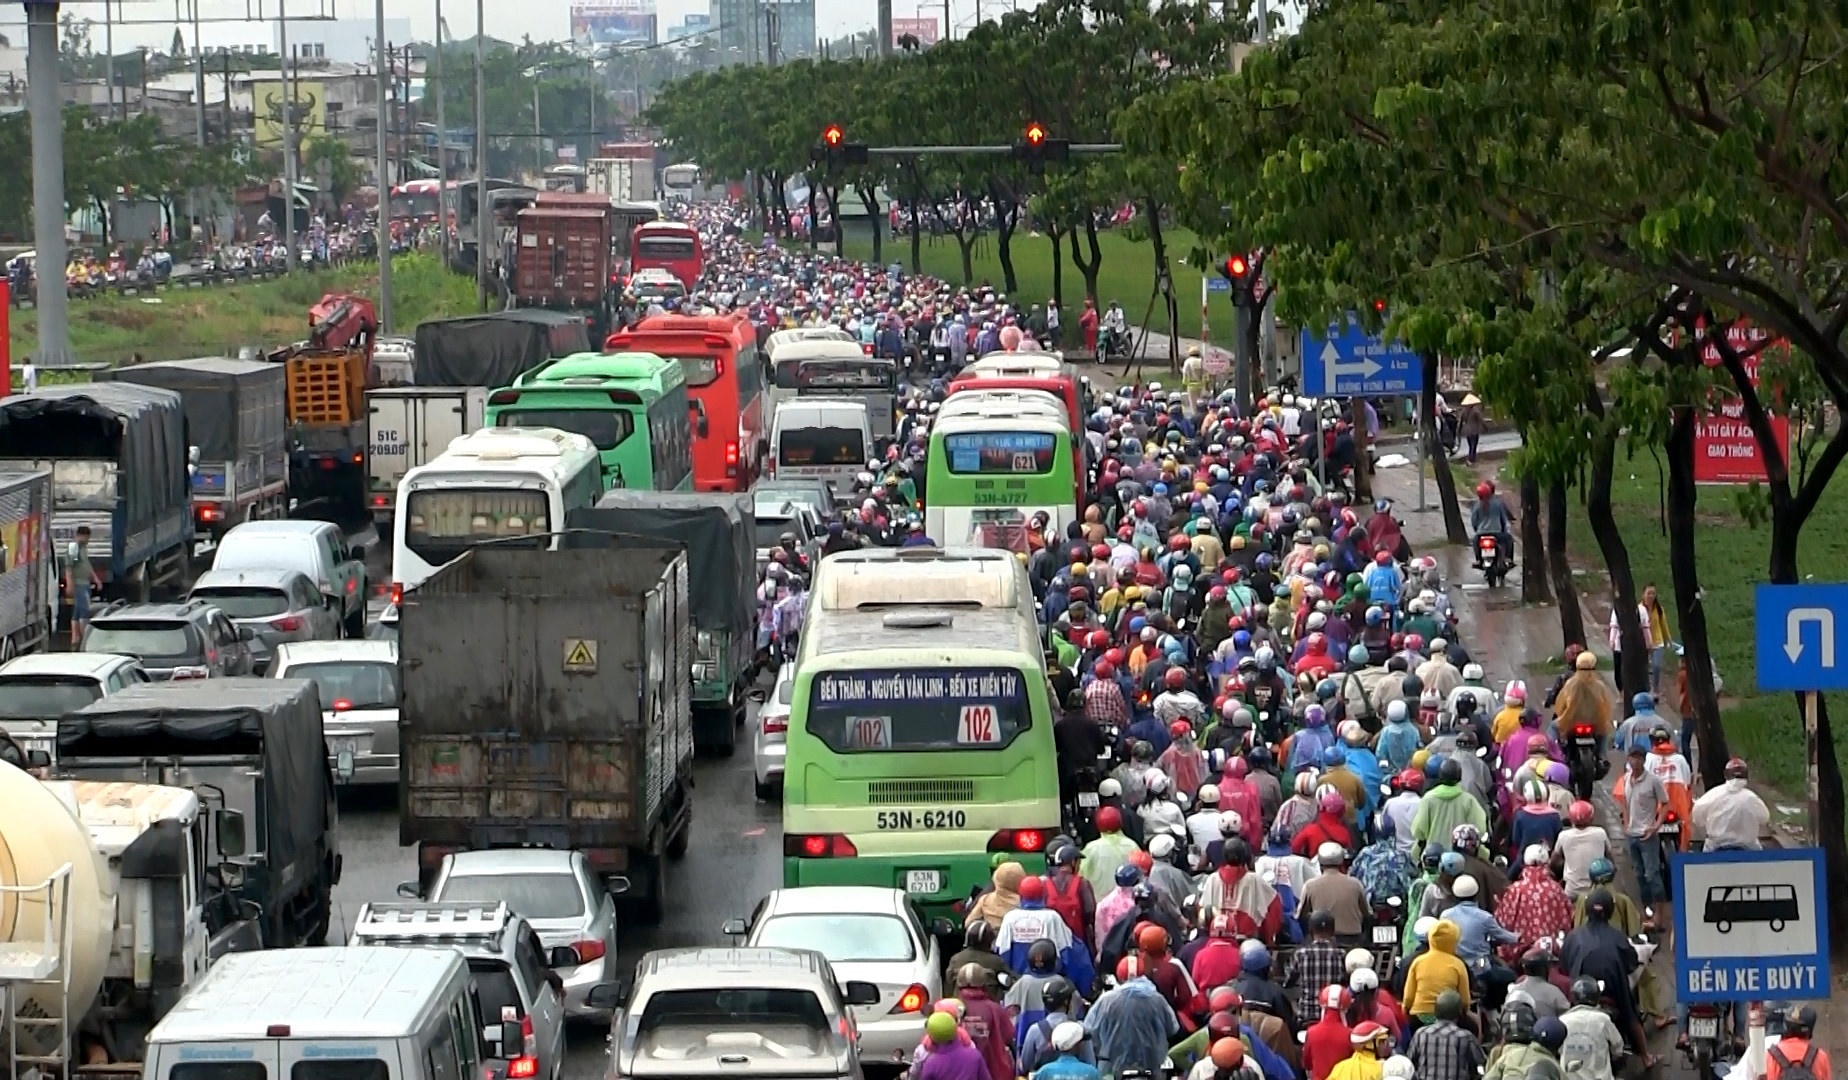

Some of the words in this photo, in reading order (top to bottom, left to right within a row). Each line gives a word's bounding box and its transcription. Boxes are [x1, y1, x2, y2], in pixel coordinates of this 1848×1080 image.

[1707, 443, 1726, 457] GIAO
[1727, 442, 1754, 458] THÔNG
[820, 676, 838, 701] BẾN
[838, 677, 866, 699] THÀNH
[924, 678, 944, 698] LINH
[949, 672, 966, 697] BẾN
[967, 677, 979, 697] XE
[1001, 672, 1017, 697] TÂY
[856, 720, 882, 746] 102
[964, 708, 992, 742] 102
[910, 882, 937, 892] 6210
[913, 871, 934, 882] 53N
[1688, 960, 1728, 993] BẾN
[1735, 967, 1760, 991] XE
[1766, 961, 1817, 990] BUÝT
